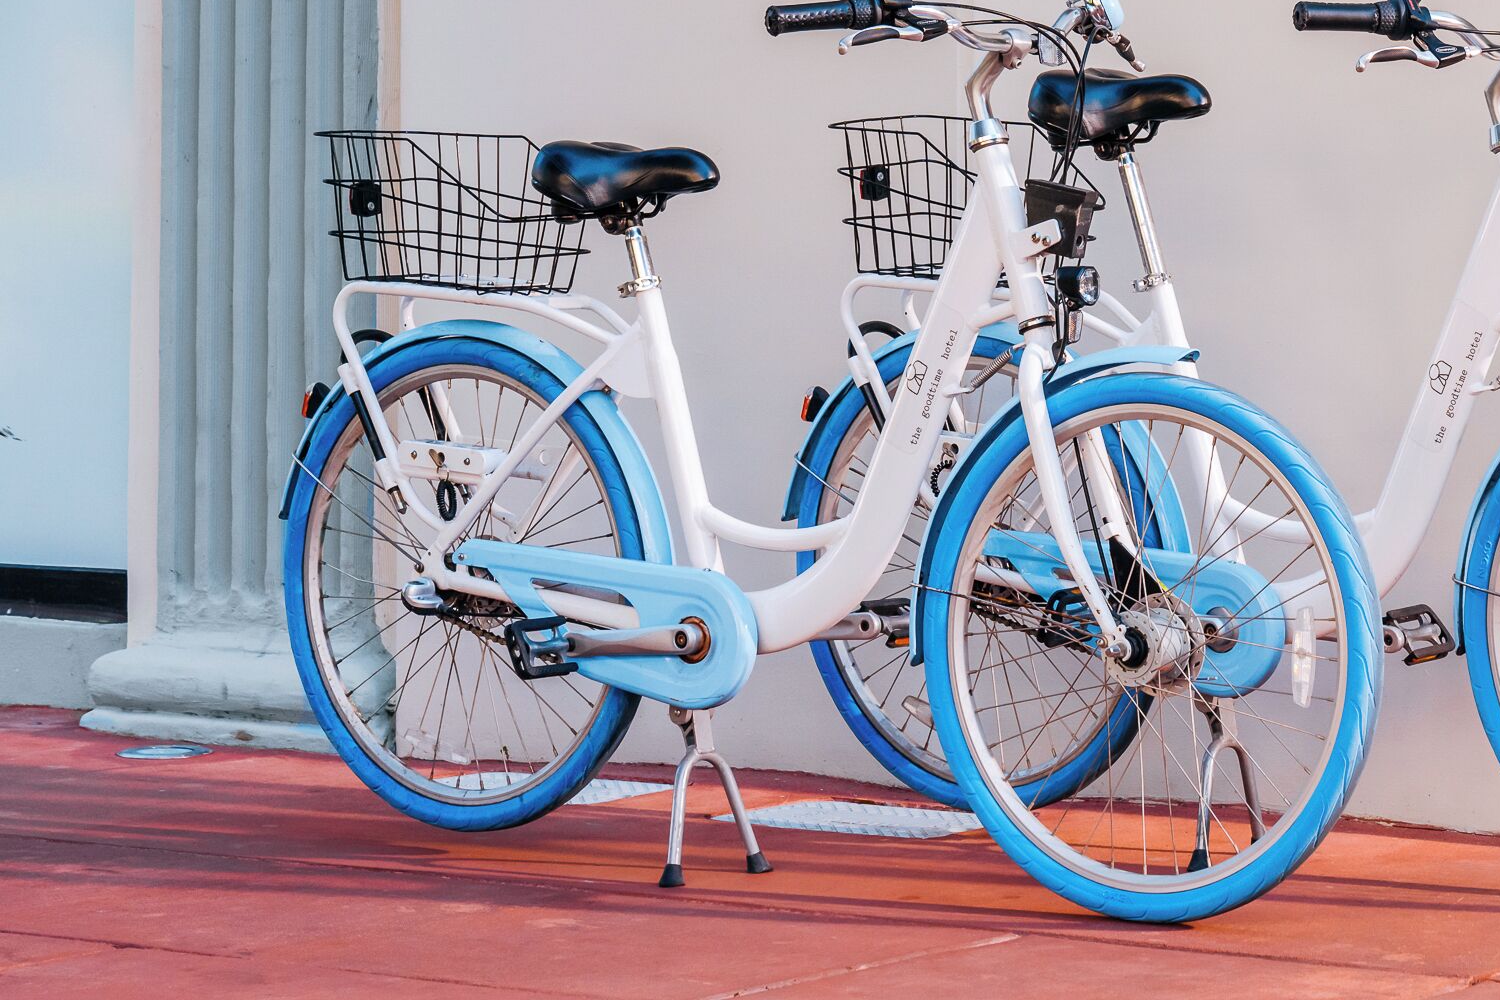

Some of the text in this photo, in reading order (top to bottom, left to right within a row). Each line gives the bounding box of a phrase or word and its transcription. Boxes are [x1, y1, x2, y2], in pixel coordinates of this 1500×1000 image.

[911, 330, 958, 444] the goodtime hotel
[1435, 331, 1482, 443] the goodtime hotel
